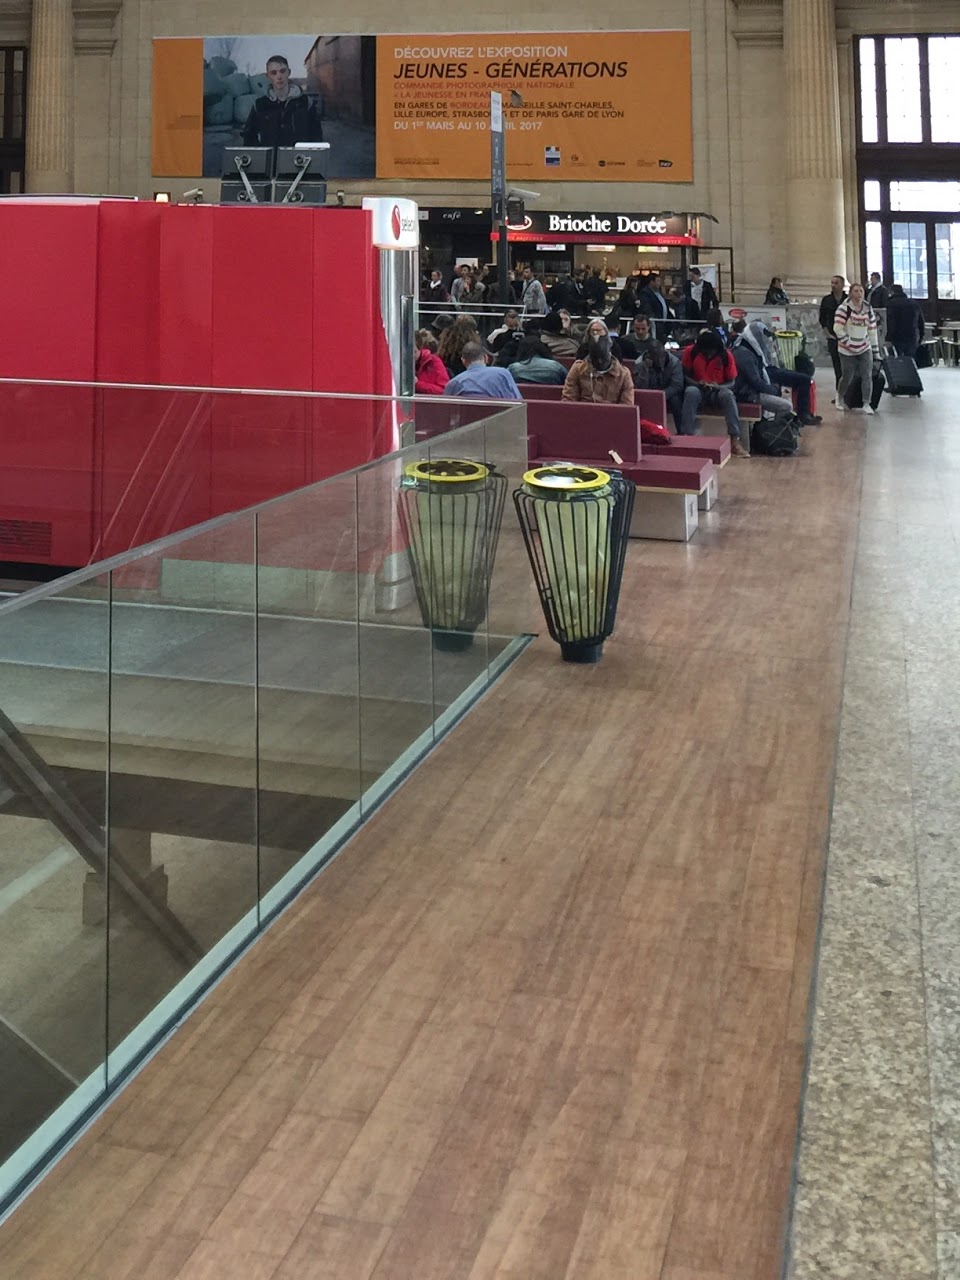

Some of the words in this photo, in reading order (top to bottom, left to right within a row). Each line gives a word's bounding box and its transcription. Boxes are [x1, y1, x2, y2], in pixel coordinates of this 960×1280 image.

[393, 46, 474, 59] DÉCOUVREZ
[478, 45, 568, 58] L'EXPOSITION
[393, 62, 468, 79] JEUNES
[486, 58, 628, 79] GÉNÉRATIONS
[562, 110, 585, 118] GARE
[588, 110, 599, 118] DE
[602, 110, 624, 118] LYON
[394, 121, 408, 130] DU
[426, 121, 455, 130] MARS
[457, 121, 471, 130] AU
[475, 121, 486, 130] 10
[520, 121, 542, 130] 2017
[549, 214, 612, 232] Brioche
[617, 216, 667, 233] Dorée
